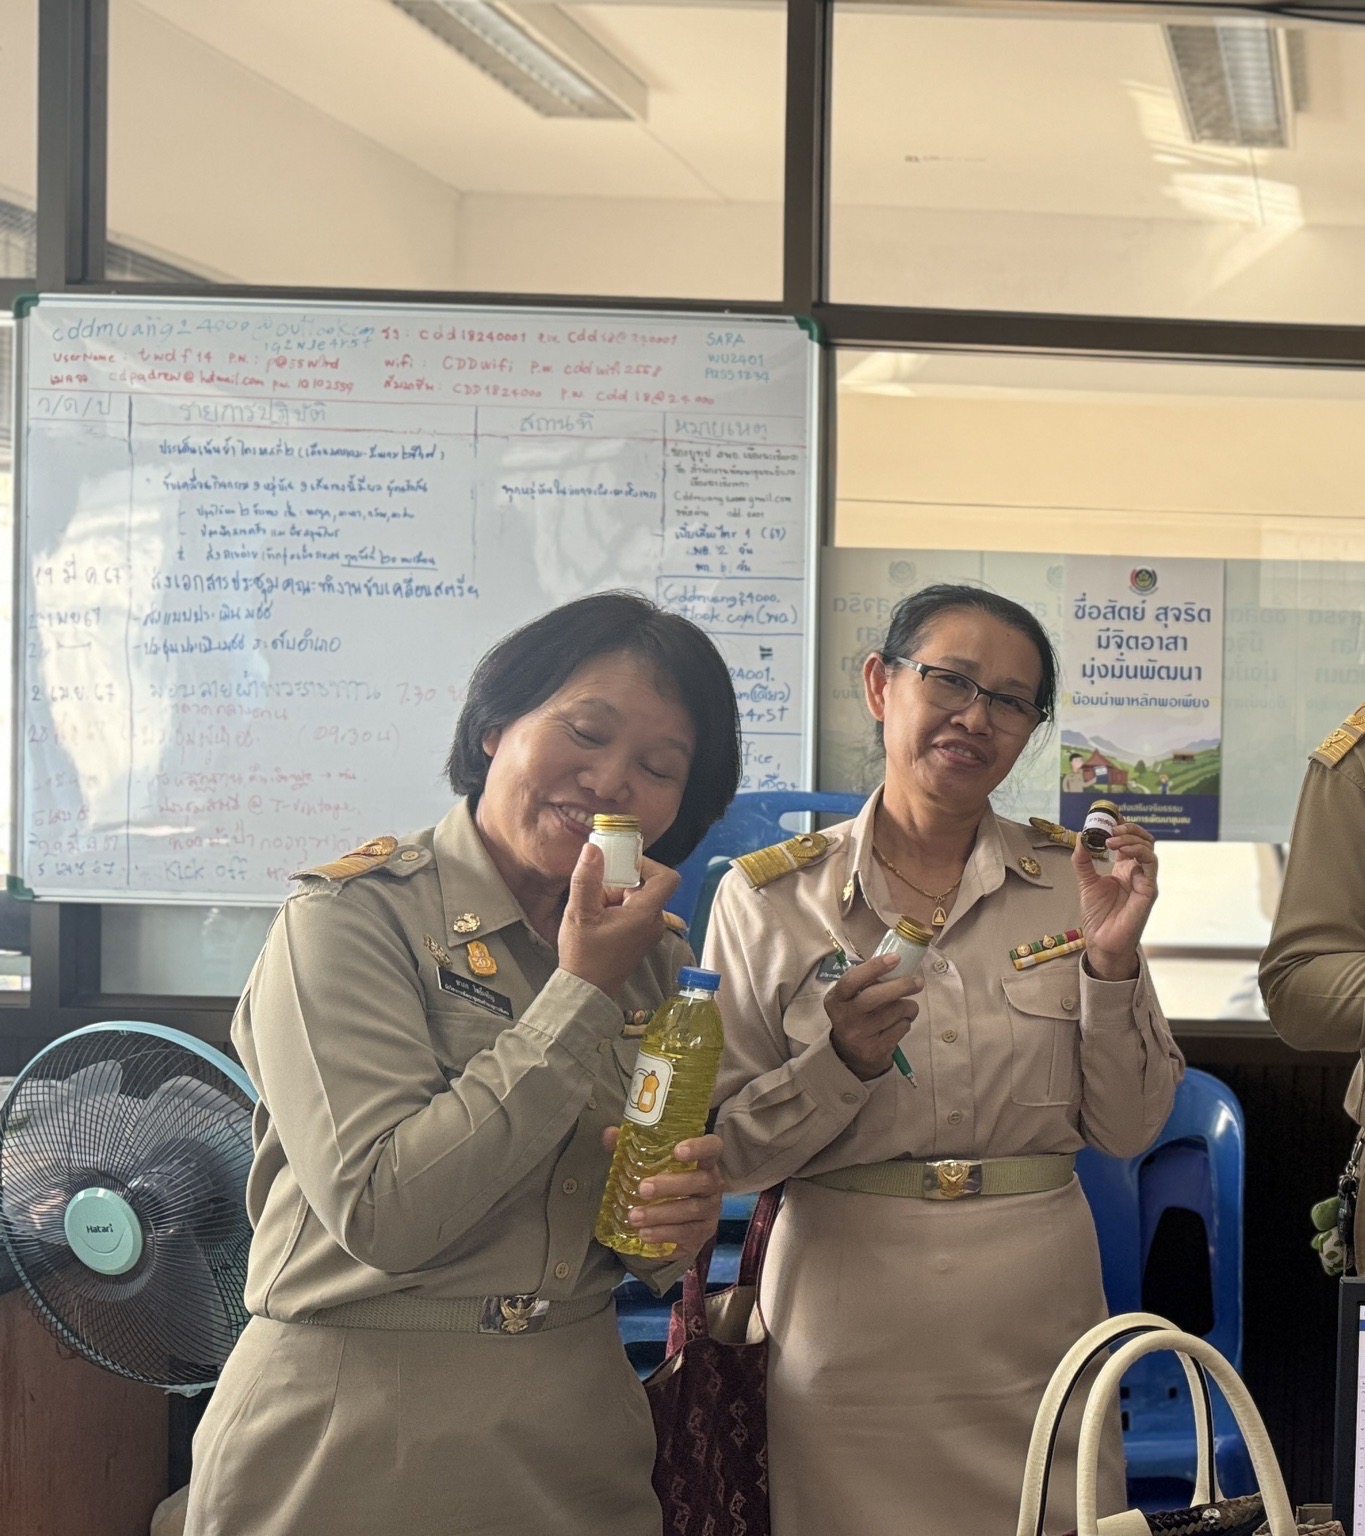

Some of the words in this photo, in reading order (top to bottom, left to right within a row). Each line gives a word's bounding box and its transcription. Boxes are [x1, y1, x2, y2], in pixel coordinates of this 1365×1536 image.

[1155, 602, 1212, 629] สุจริต
[1097, 627, 1189, 651] มีจิตอาสา
[1082, 652, 1202, 686] มุ่งมั่นพัฒนา
[86, 1223, 114, 1234] Hatari
